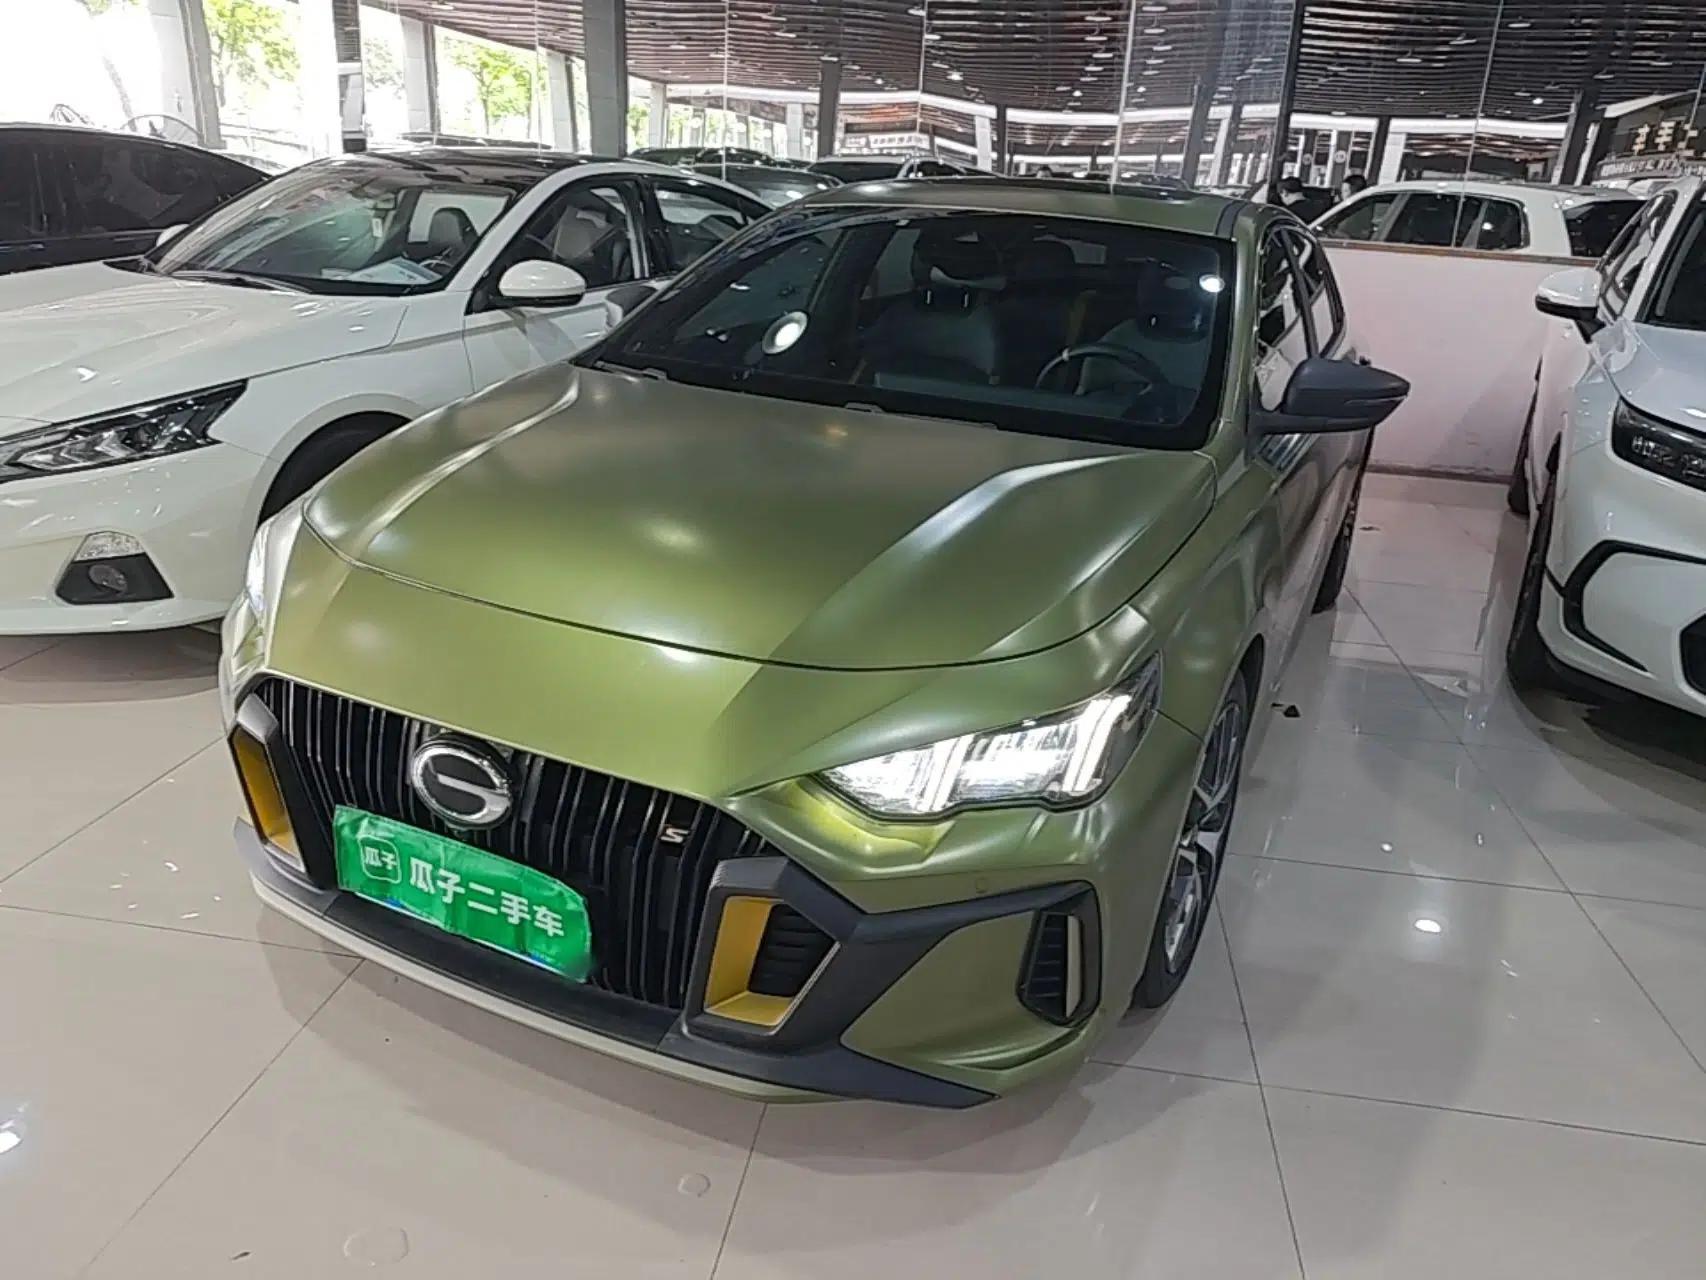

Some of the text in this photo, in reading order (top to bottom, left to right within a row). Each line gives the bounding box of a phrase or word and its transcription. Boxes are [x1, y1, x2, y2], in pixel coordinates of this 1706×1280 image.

[363, 846, 397, 870] 瓜子
[409, 856, 565, 937] 瓜子二手车
